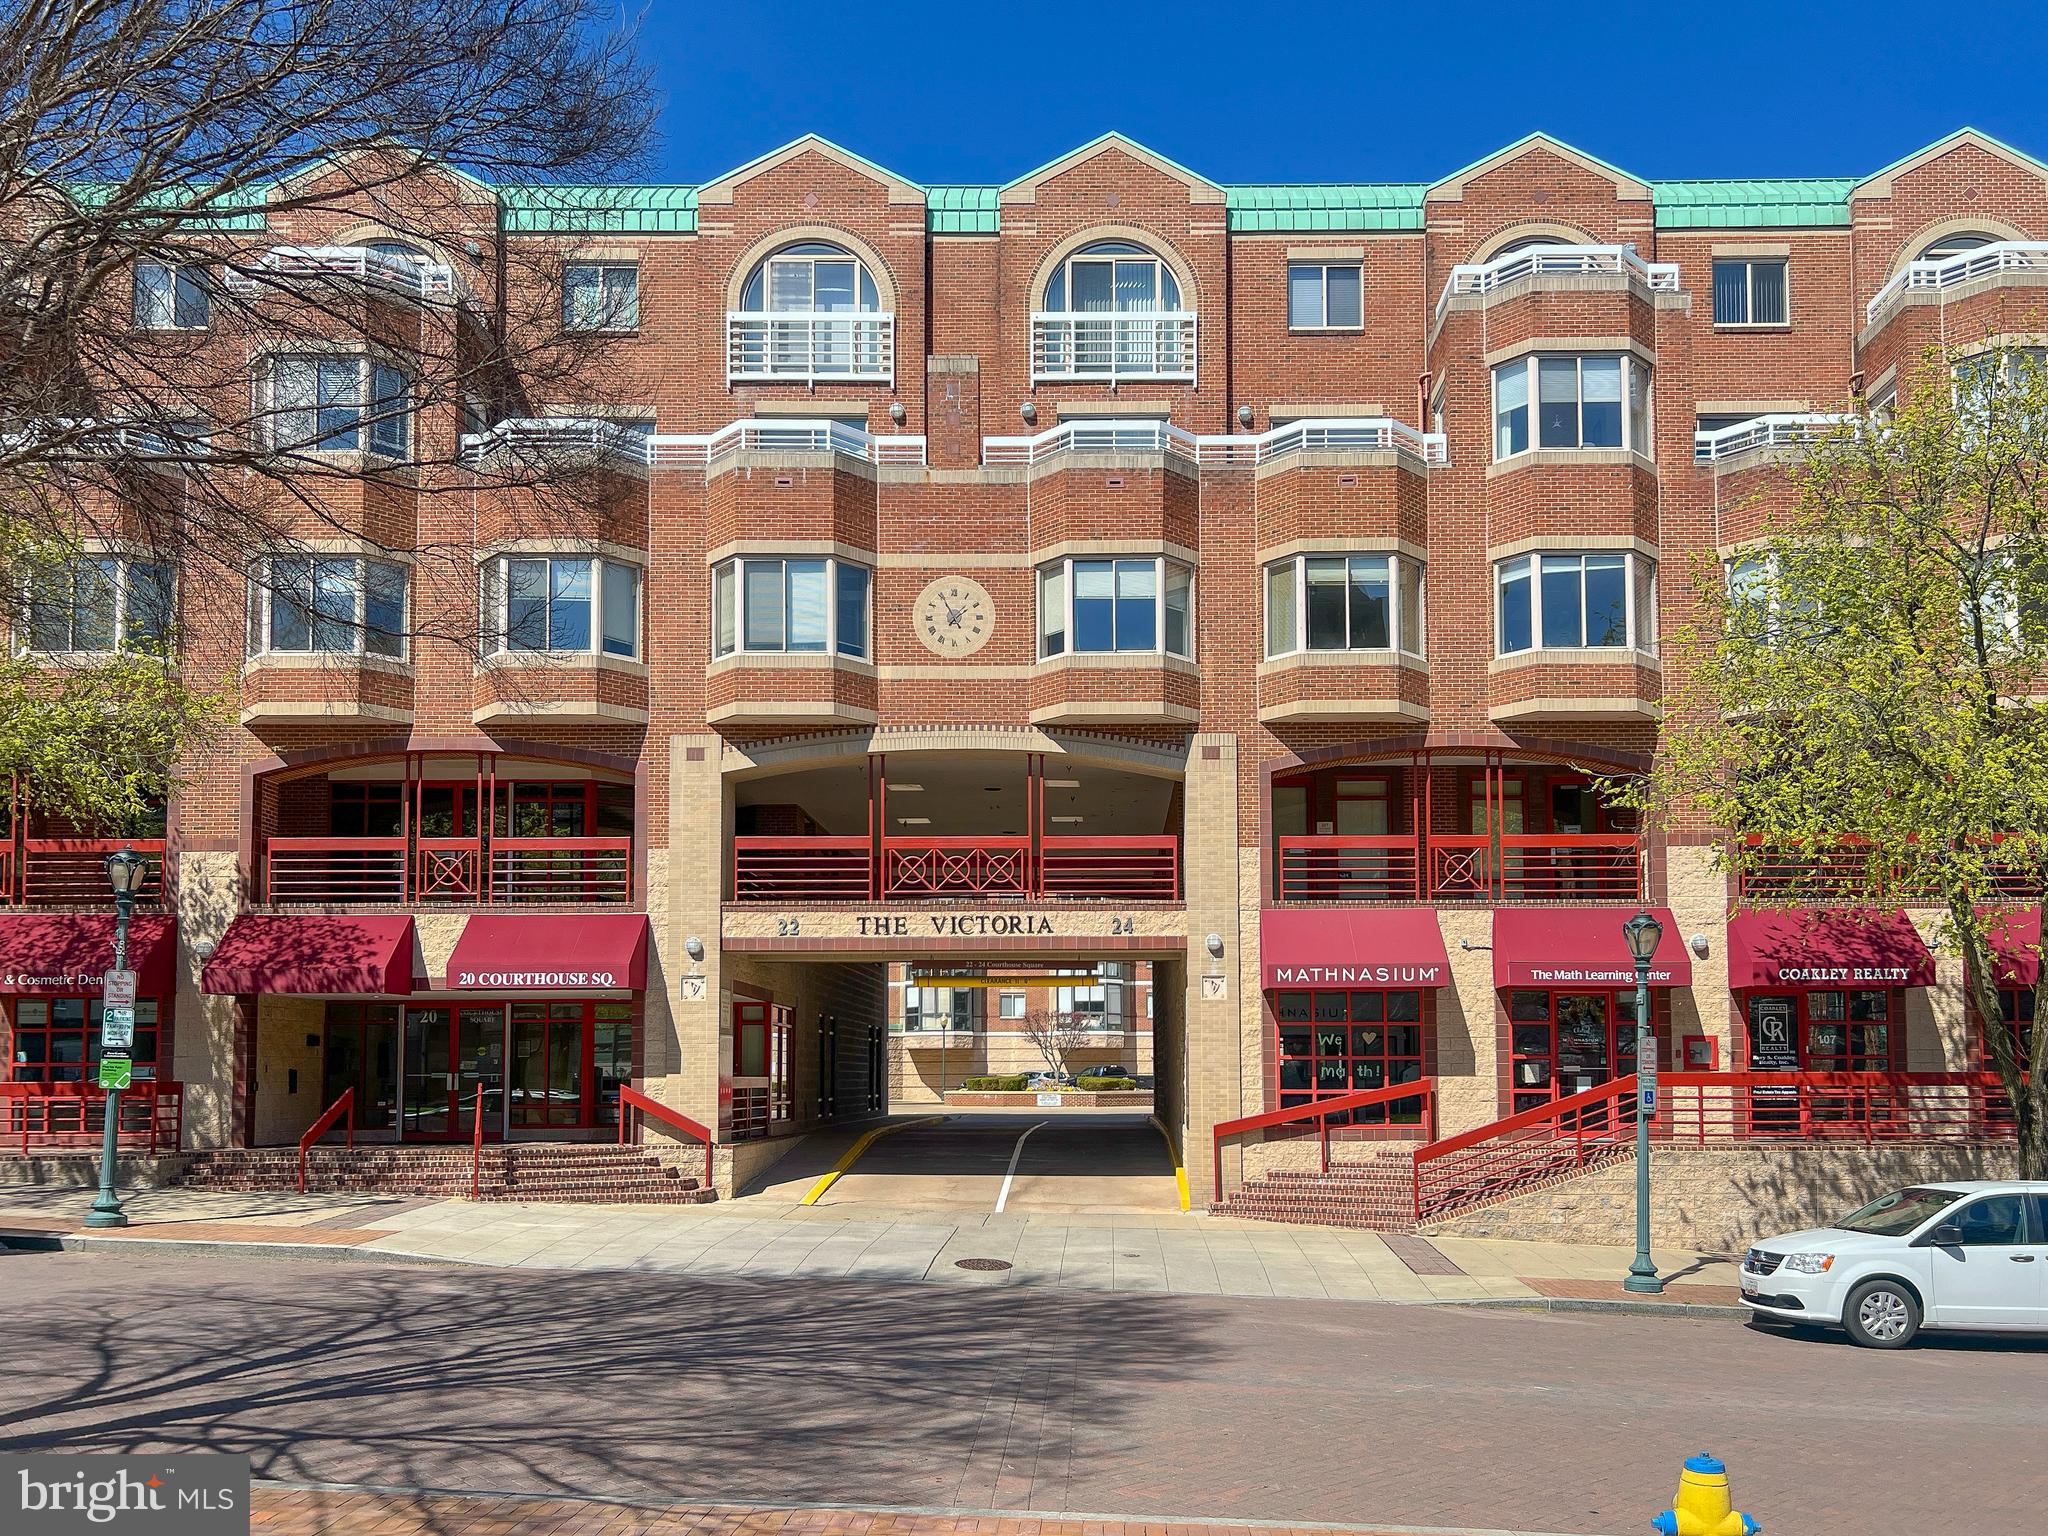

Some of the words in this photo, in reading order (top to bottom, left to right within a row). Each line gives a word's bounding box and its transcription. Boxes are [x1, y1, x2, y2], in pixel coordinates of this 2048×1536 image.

[778, 918, 800, 936] 22
[856, 916, 909, 936] THE
[930, 915, 1054, 936] VICTORIA
[1111, 917, 1134, 935] 24
[986, 960, 1021, 968] Courthouse
[1022, 961, 1044, 969] Square
[4, 975, 15, 985] &
[18, 974, 74, 985] Cosmetic
[78, 974, 106, 985] Den
[458, 973, 475, 985] 20
[478, 973, 588, 985] COURTHOUSE
[591, 973, 616, 987] SQ.
[1276, 967, 1435, 982] MATHNASIUM
[1531, 970, 1551, 980] The
[1554, 970, 1582, 980] Math
[1585, 970, 1633, 983] Learning
[1635, 971, 1671, 980] nter
[1779, 968, 1848, 980] COAKLEY
[1854, 968, 1909, 980] REALTY
[106, 1011, 113, 1021] 2
[420, 1010, 437, 1023] 20
[1318, 1033, 1342, 1046] We
[1818, 1035, 1836, 1044] 107
